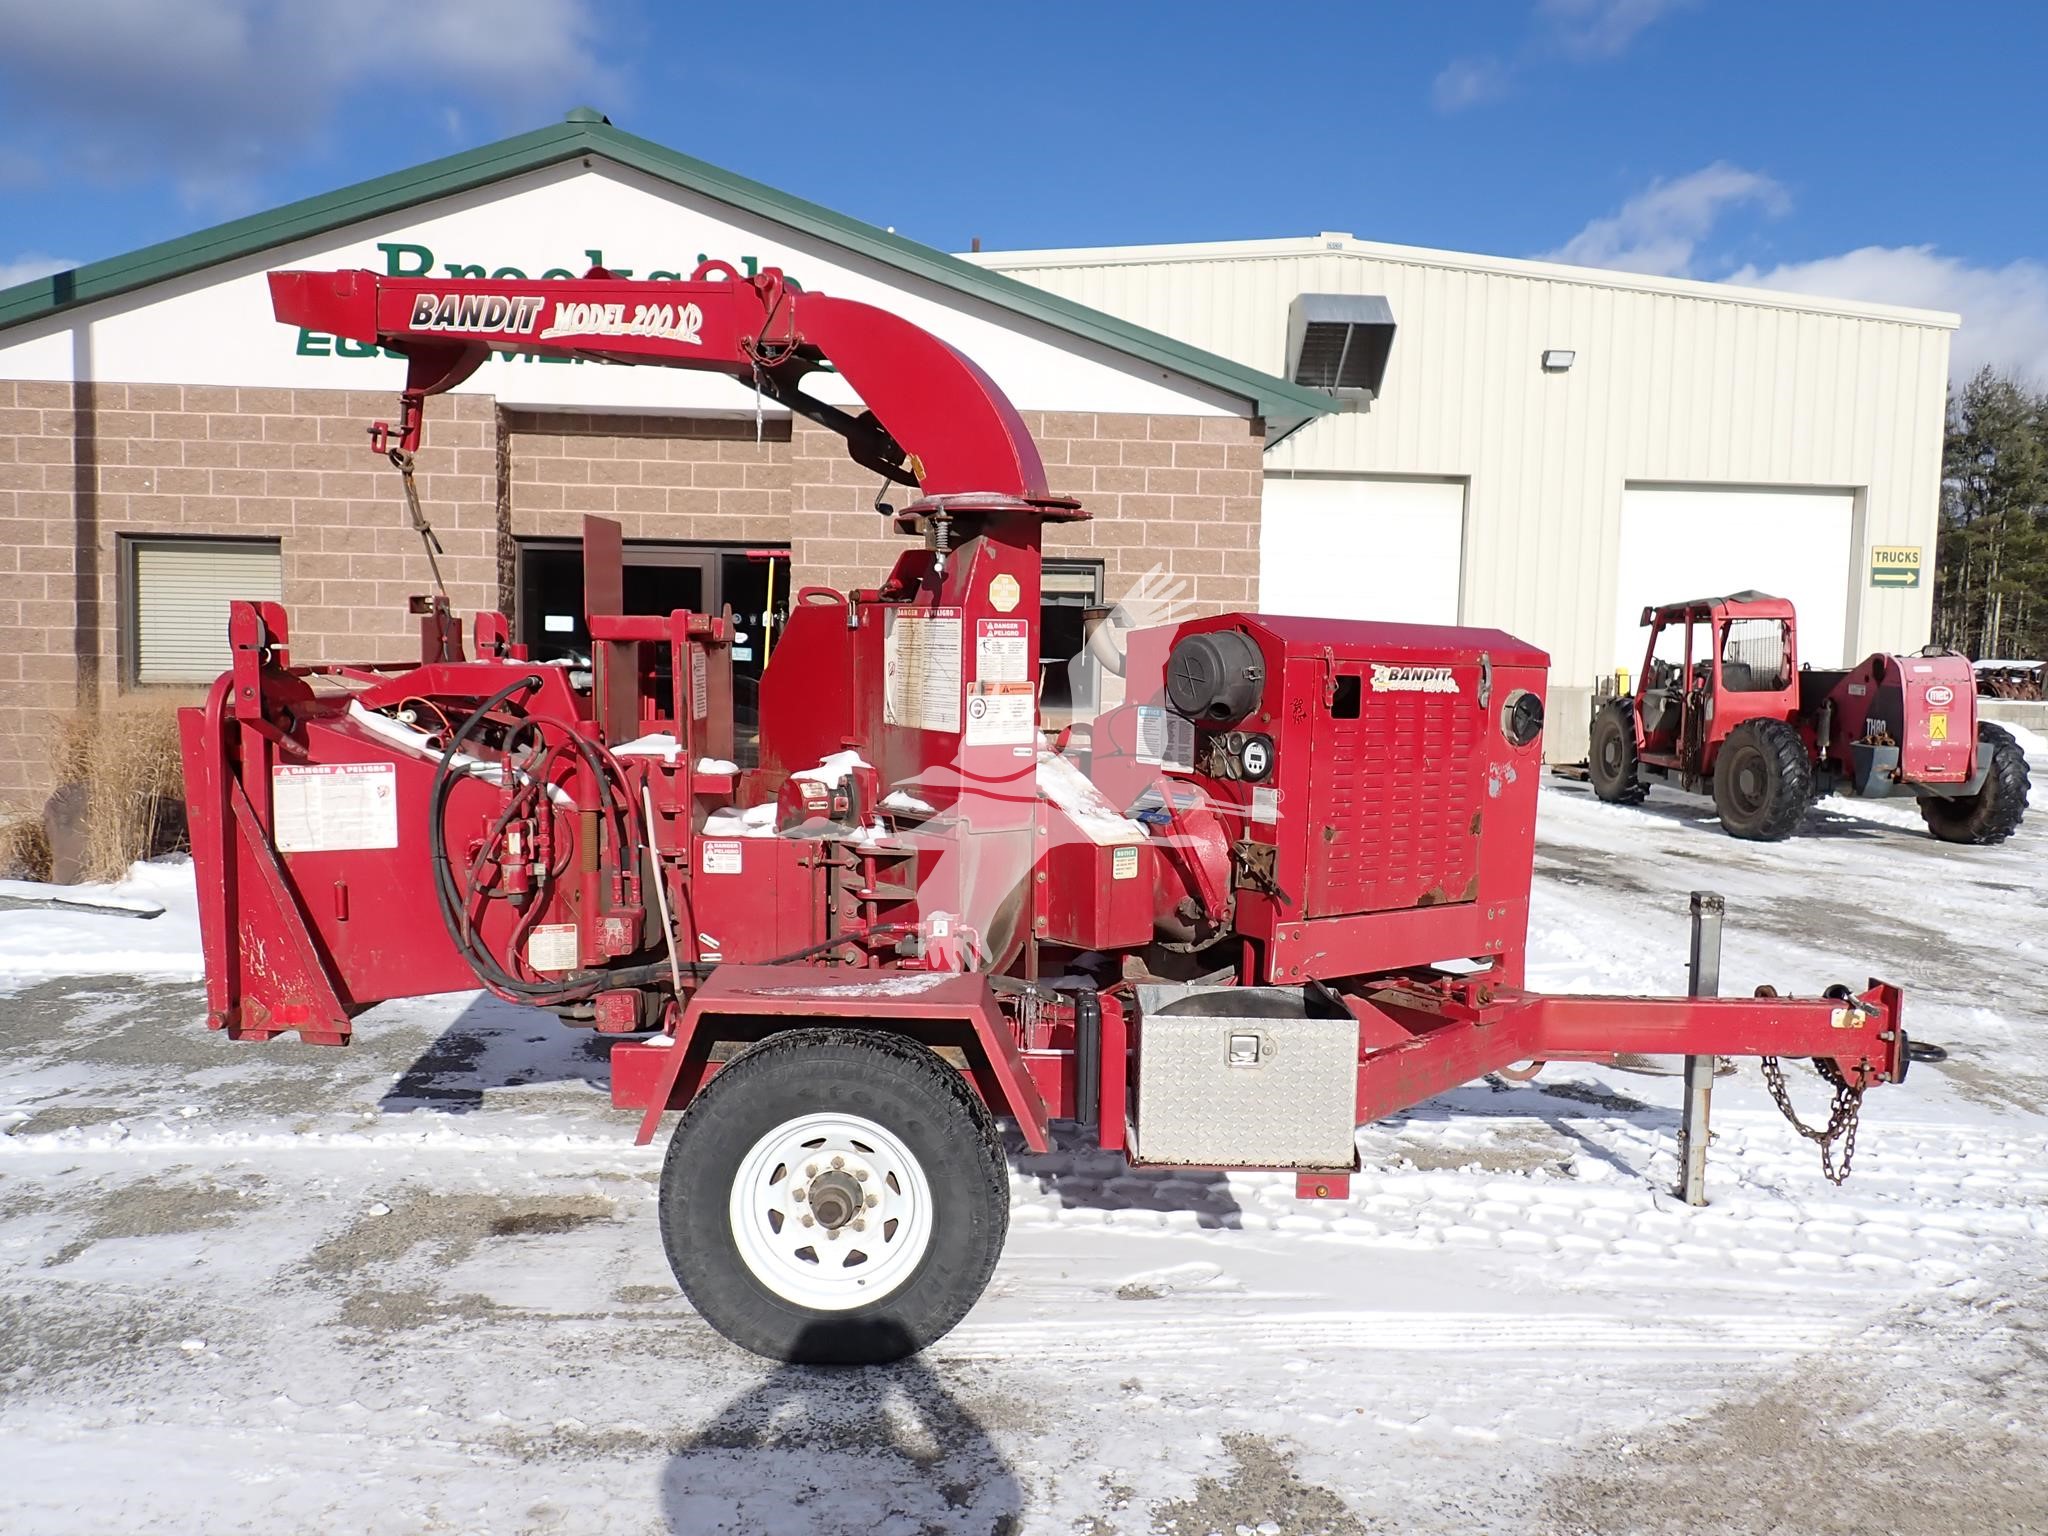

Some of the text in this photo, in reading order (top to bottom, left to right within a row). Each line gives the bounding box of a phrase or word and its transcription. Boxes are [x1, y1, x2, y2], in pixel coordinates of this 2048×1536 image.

[410, 293, 544, 333] BANDIT
[553, 302, 625, 334] MODEL
[630, 304, 674, 337] 200
[1875, 551, 1919, 563] TRUCKS
[1388, 667, 1451, 682] BANDIT
[291, 765, 387, 775] DANGER PELIGRO
